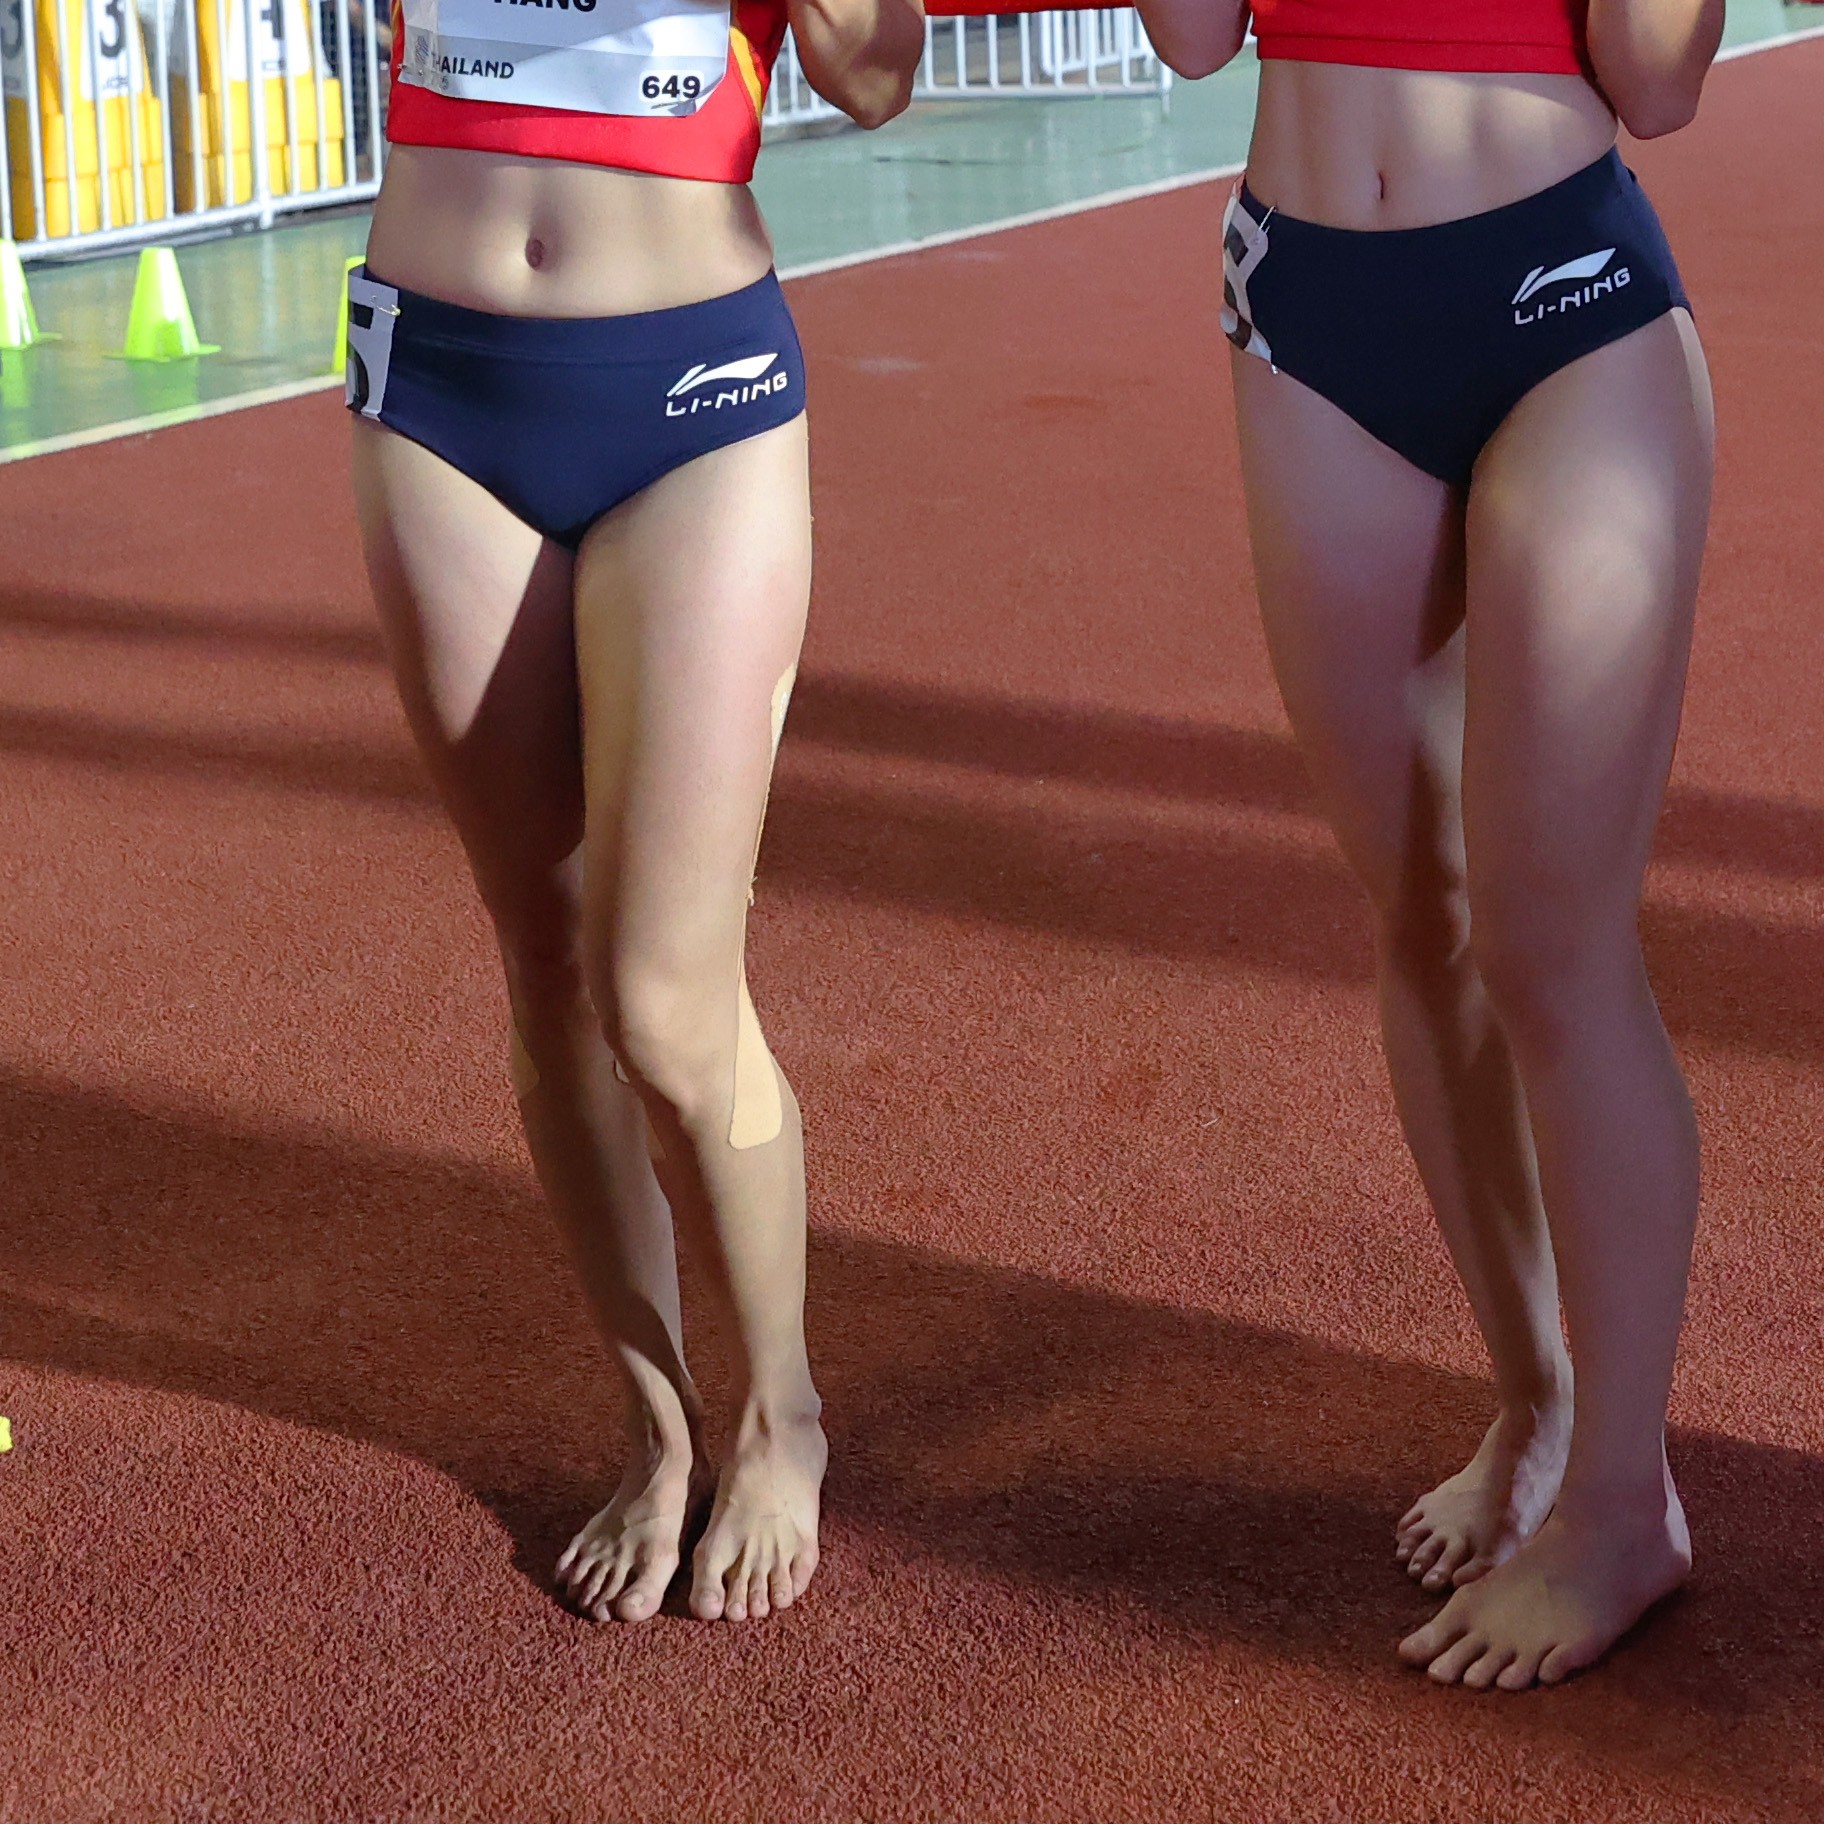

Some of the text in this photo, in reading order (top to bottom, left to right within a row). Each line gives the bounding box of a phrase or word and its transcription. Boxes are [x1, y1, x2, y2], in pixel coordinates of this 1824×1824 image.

[642, 75, 701, 99] 649
[1514, 267, 1631, 325] LI-NING
[665, 371, 788, 417] LI-NING
